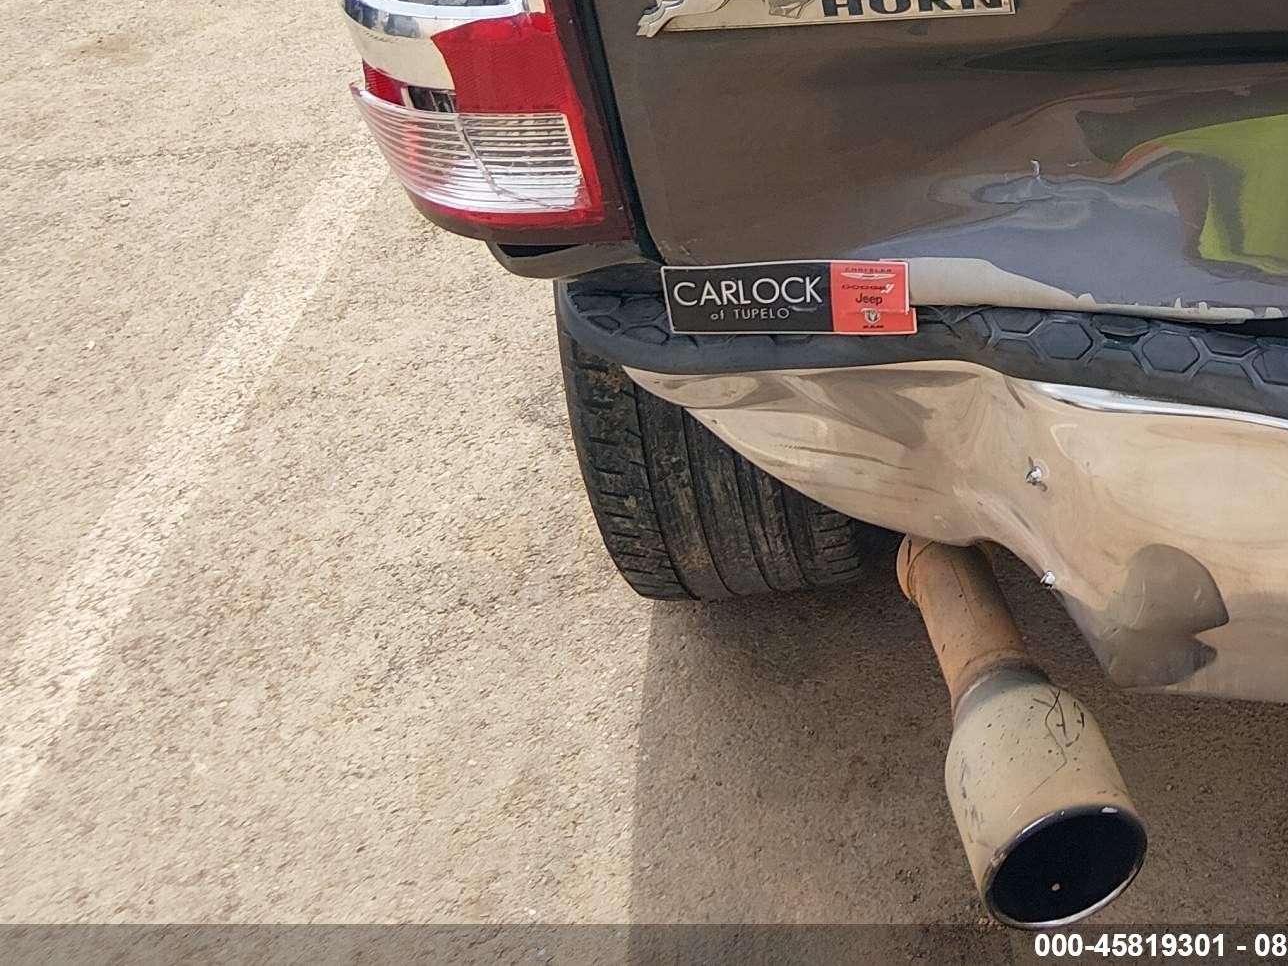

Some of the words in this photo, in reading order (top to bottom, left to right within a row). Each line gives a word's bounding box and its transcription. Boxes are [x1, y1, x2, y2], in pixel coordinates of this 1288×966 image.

[673, 276, 823, 307] CARLOCK
[856, 292, 883, 306] Jeep
[710, 308, 725, 321] of
[734, 307, 790, 320] TUPELO
